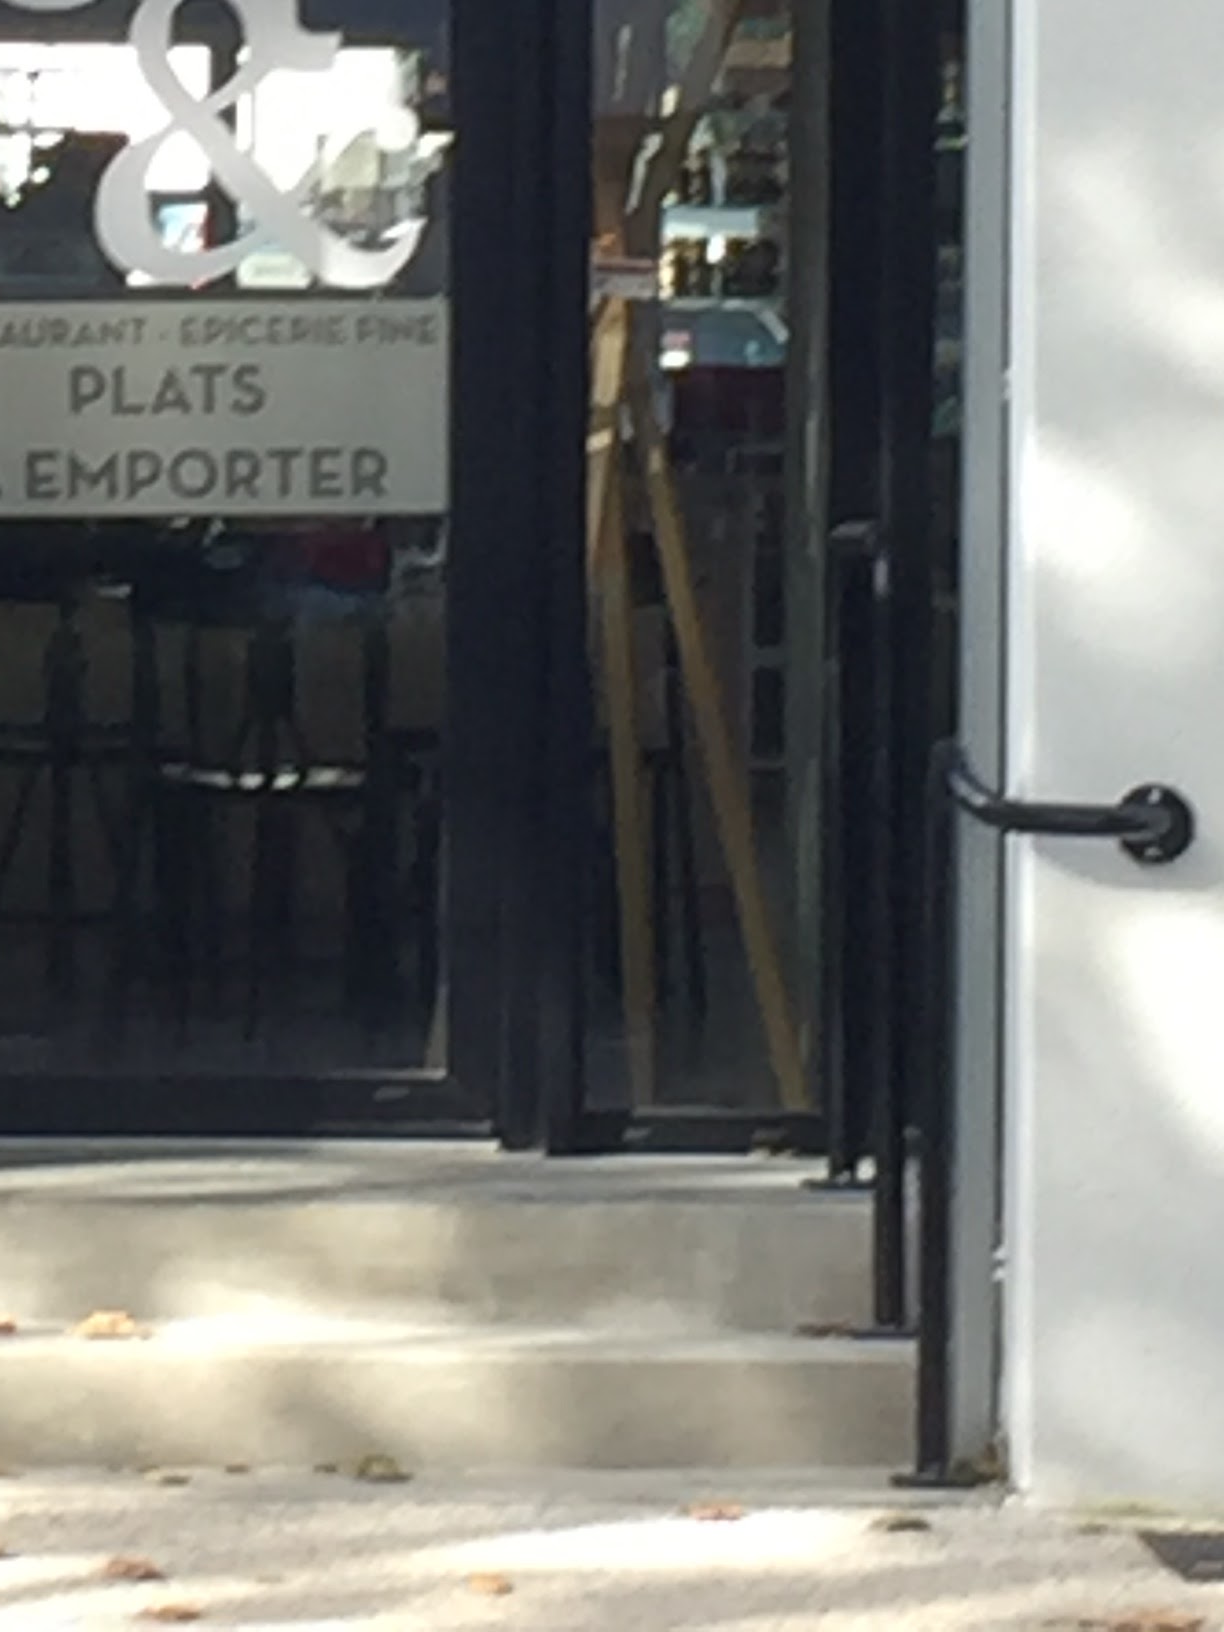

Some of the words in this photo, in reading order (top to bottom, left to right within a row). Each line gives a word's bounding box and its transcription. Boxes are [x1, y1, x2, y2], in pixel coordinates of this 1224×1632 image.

[180, 314, 348, 345] EPICERIE
[356, 314, 439, 345] FINE
[68, 365, 267, 415] PLATS
[25, 447, 388, 500] EMPORTER
